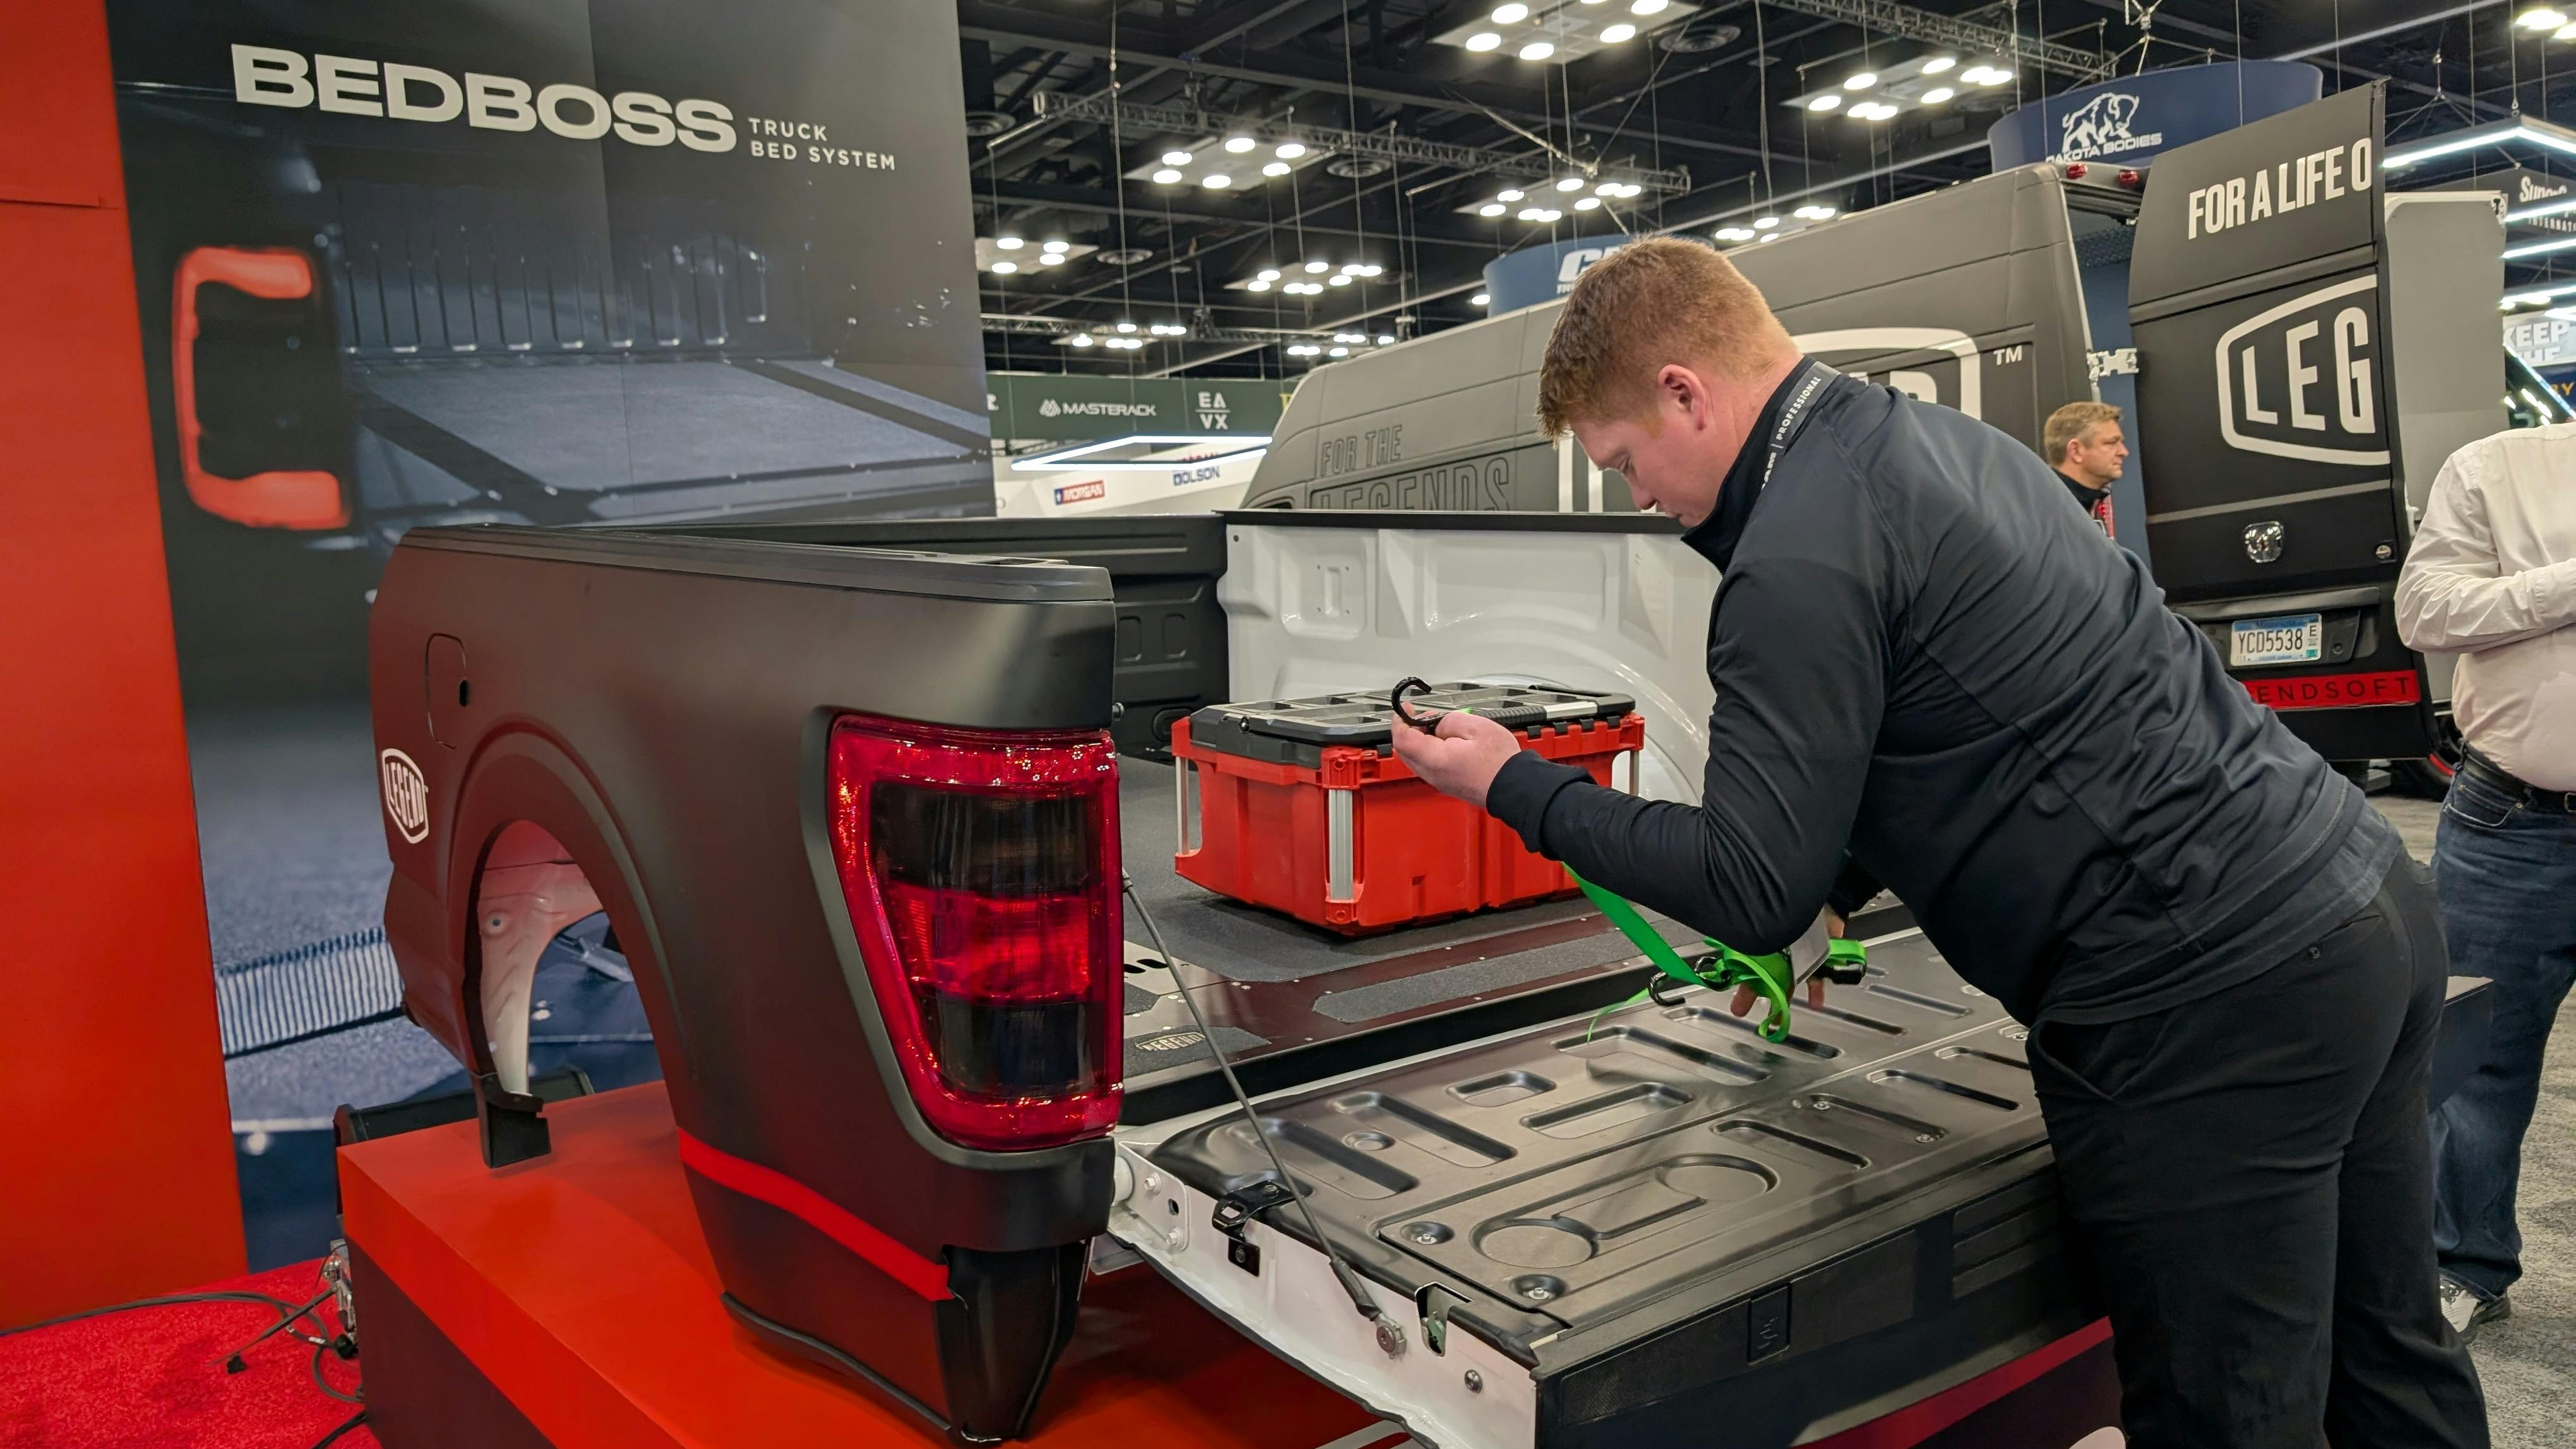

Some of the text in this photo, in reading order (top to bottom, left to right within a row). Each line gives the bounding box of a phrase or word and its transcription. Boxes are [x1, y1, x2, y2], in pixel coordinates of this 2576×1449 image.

[232, 44, 737, 153] BEDBOSS
[748, 117, 828, 142] TRUCK
[2103, 132, 2162, 155] BODIES
[751, 140, 895, 171] BED SYSTEM
[2188, 137, 2372, 240] FOR A LIFE O
[1993, 345, 2023, 366] TM
[2241, 306, 2376, 434] LEG
[1063, 401, 1157, 417] MASTERACK
[1198, 391, 1226, 408] EA
[1775, 376, 1822, 441] PROFESSIONAL
[1200, 413, 1229, 430] VX
[1320, 424, 1402, 477] FOR THE
[1062, 482, 1103, 502] MORGAN
[2238, 628, 2303, 654] YCD5538
[2310, 625, 2317, 637] E
[2256, 676, 2410, 704] ENDSOFT
[386, 761, 425, 828] LEGEND
